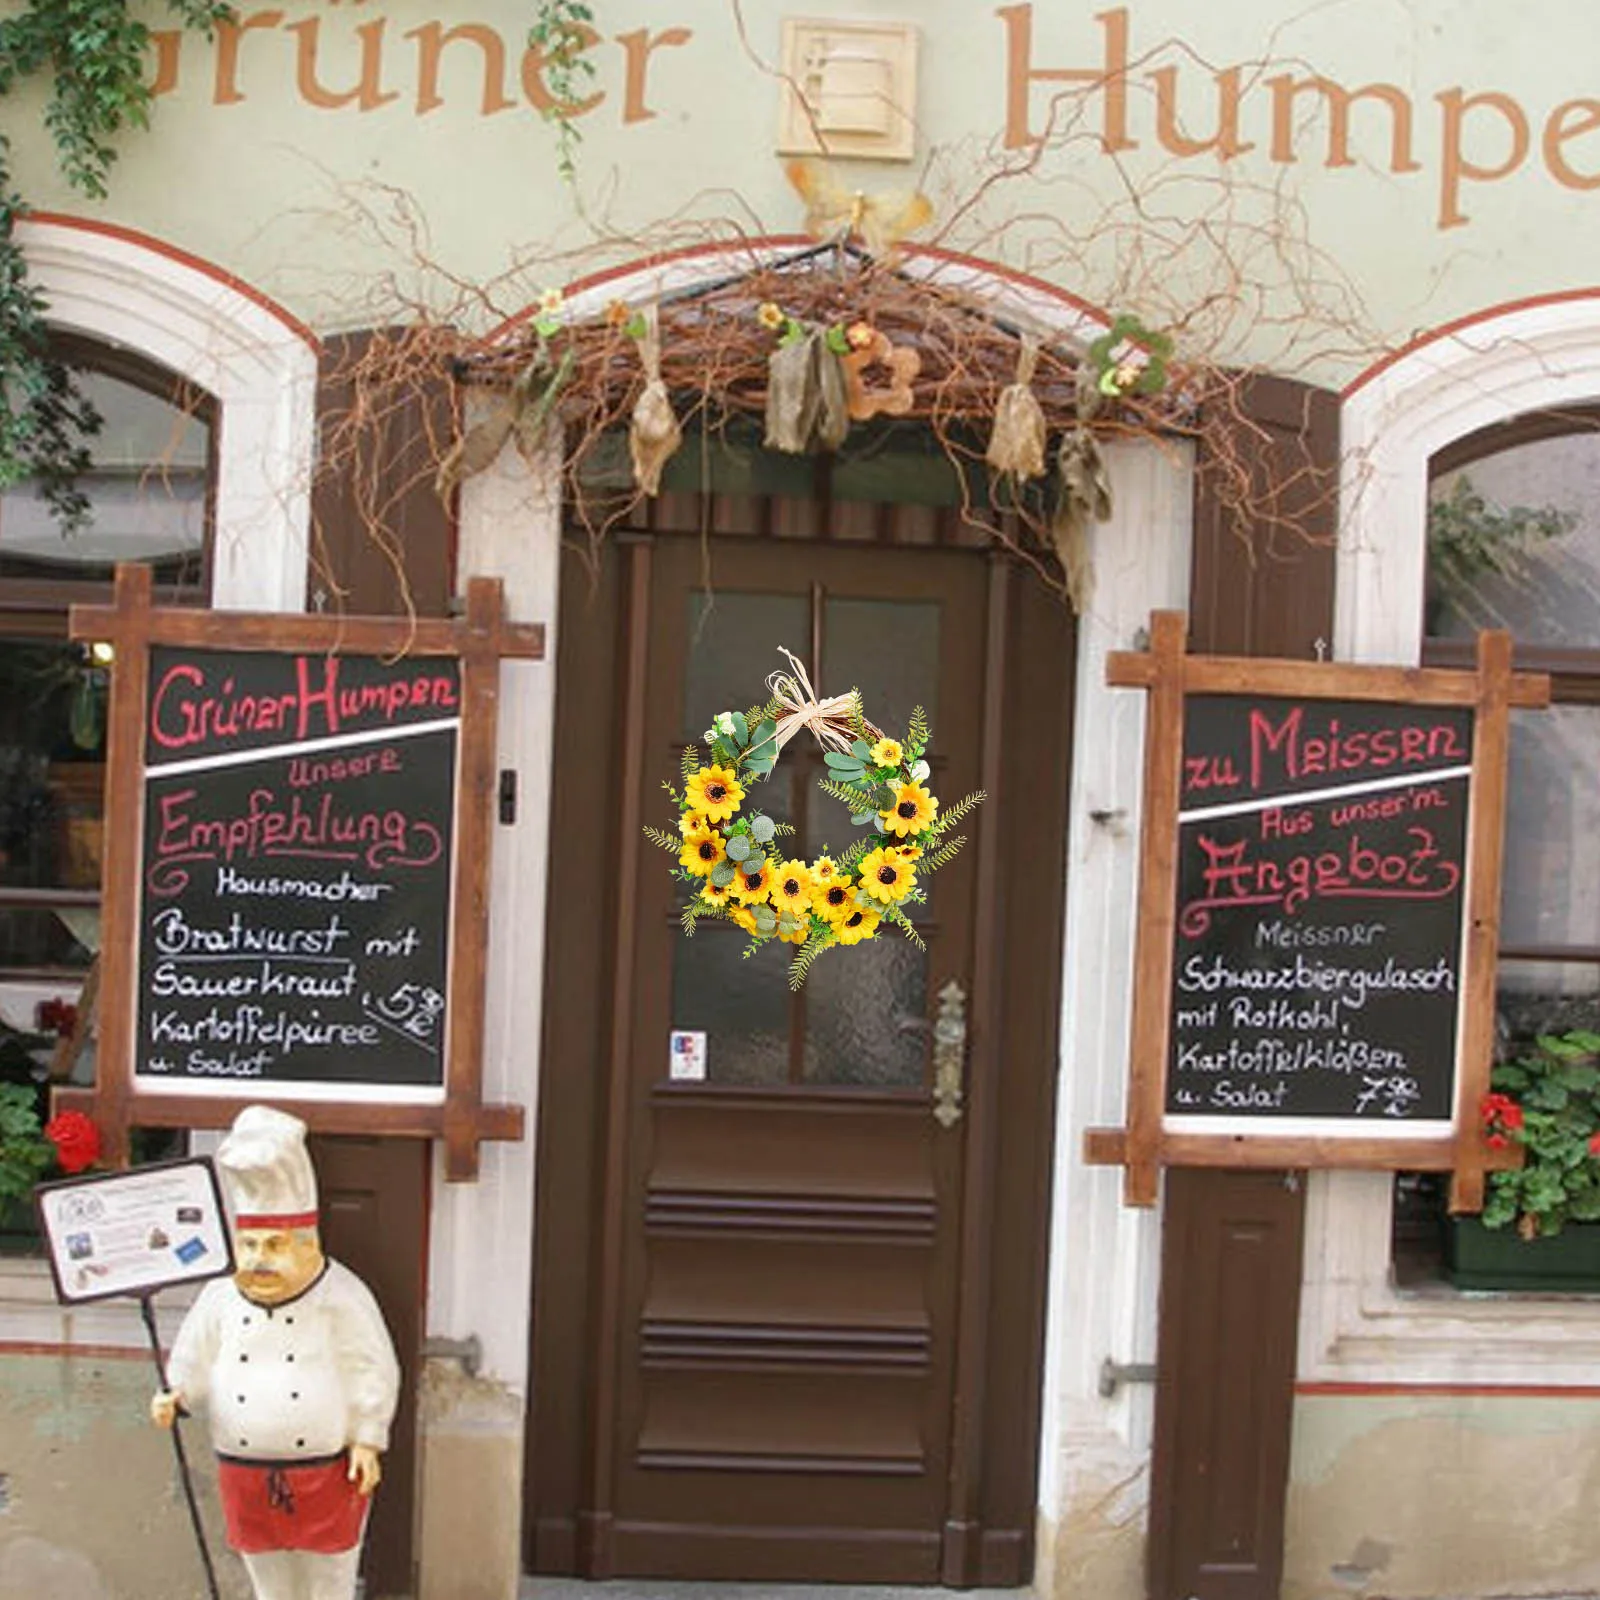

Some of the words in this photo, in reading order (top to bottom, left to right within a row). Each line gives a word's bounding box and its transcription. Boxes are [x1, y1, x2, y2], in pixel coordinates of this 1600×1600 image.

[146, 0, 693, 126] rüner
[995, 3, 1600, 230] Humpe
[1185, 755, 1240, 790] zu
[1249, 707, 1465, 789] Meissen
[157, 789, 406, 868] Empfehlung
[1260, 805, 1314, 840] Aus
[215, 866, 393, 901] Hausmacher
[152, 907, 350, 953] Bratwurst
[364, 928, 420, 957] mit
[1255, 921, 1387, 948] Meissner
[1178, 954, 1455, 1009] Schwarzbiergulasch
[1176, 1003, 1218, 1028] mit
[187, 1049, 274, 1076] Salat
[1209, 1081, 1289, 1108] Salat
